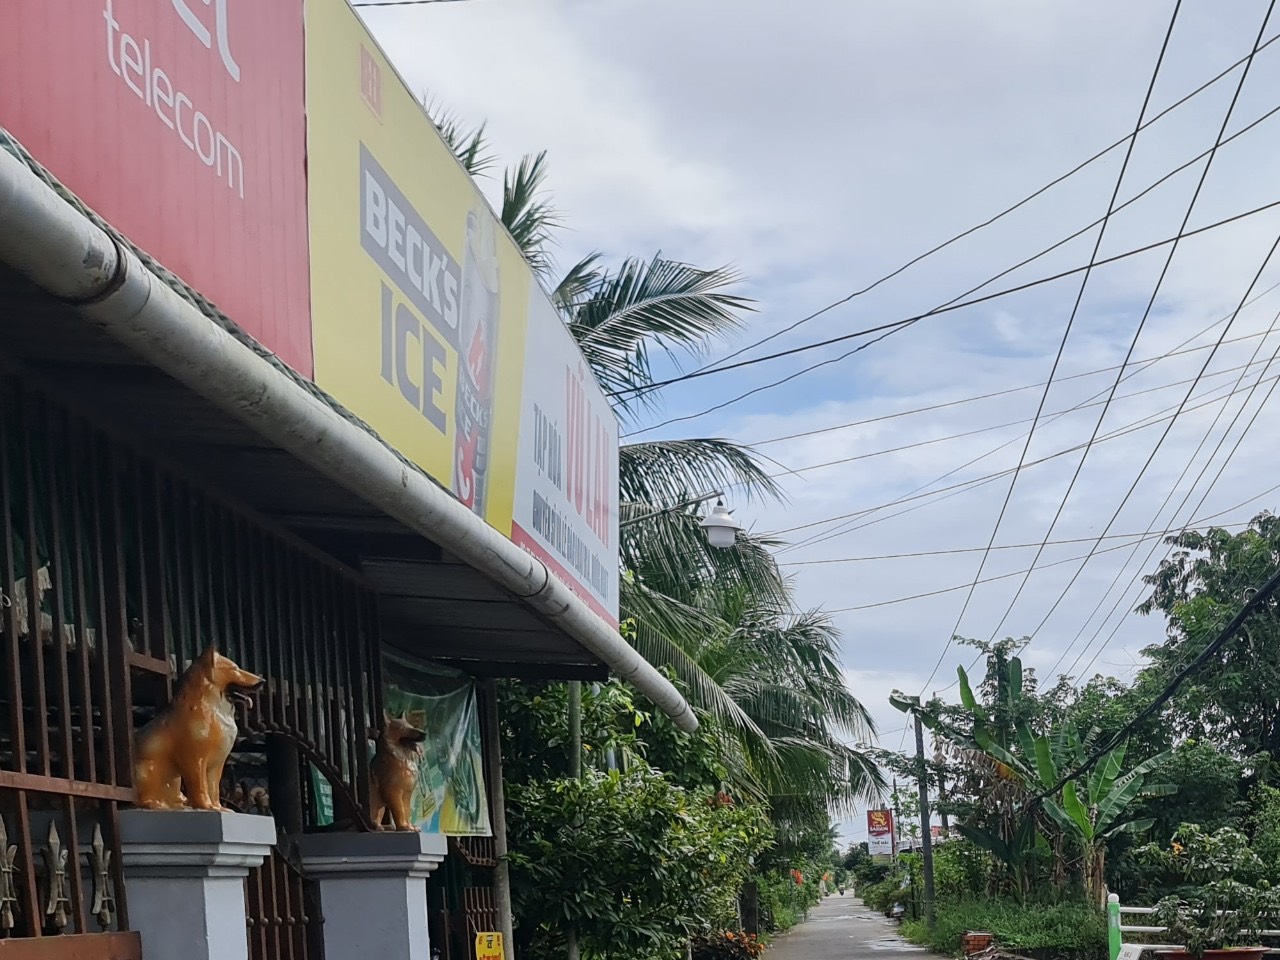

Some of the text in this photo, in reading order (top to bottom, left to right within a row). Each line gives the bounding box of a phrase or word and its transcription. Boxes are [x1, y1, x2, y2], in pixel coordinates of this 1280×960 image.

[103, 0, 244, 200] telecom
[365, 168, 458, 330] BECK'S
[380, 279, 447, 436] ICE
[533, 401, 547, 476] TẠP
